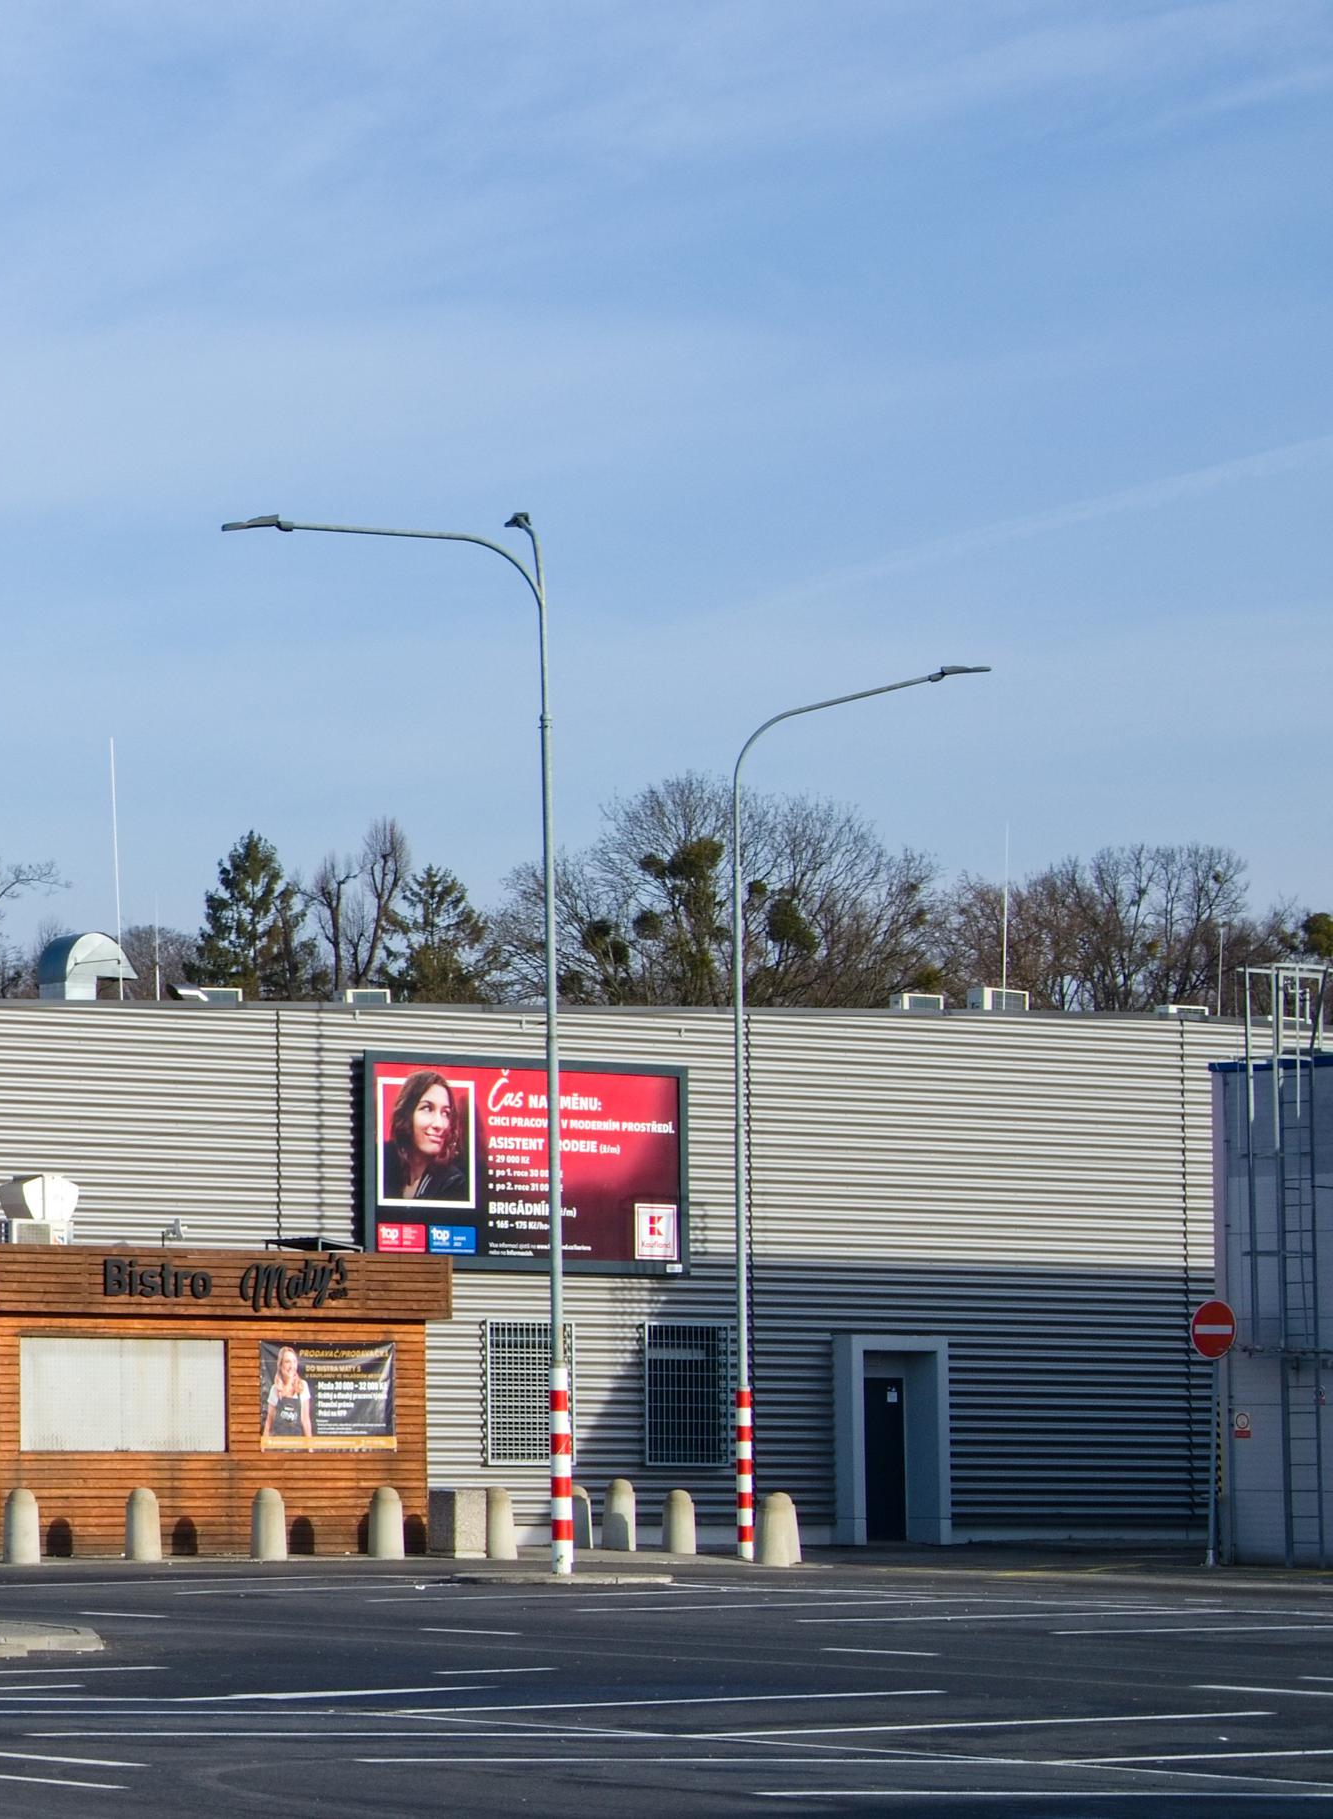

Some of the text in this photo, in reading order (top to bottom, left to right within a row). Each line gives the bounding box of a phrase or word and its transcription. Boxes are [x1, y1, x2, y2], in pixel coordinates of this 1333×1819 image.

[488, 1069, 523, 1112] Čas
[528, 1094, 548, 1109] NA
[488, 1116, 510, 1126] CHCI
[561, 1119, 568, 1128] V
[569, 1118, 620, 1131] MODERNÍM
[621, 1121, 675, 1134] PROSTŘEDÍ.
[488, 1136, 545, 1151] ASISTENT
[496, 1155, 505, 1163] 29
[506, 1156, 520, 1164] 000
[496, 1170, 505, 1178] po
[496, 1184, 505, 1192] po
[380, 1226, 399, 1240] top
[431, 1227, 450, 1241] top
[103, 1259, 212, 1299] Bistro
